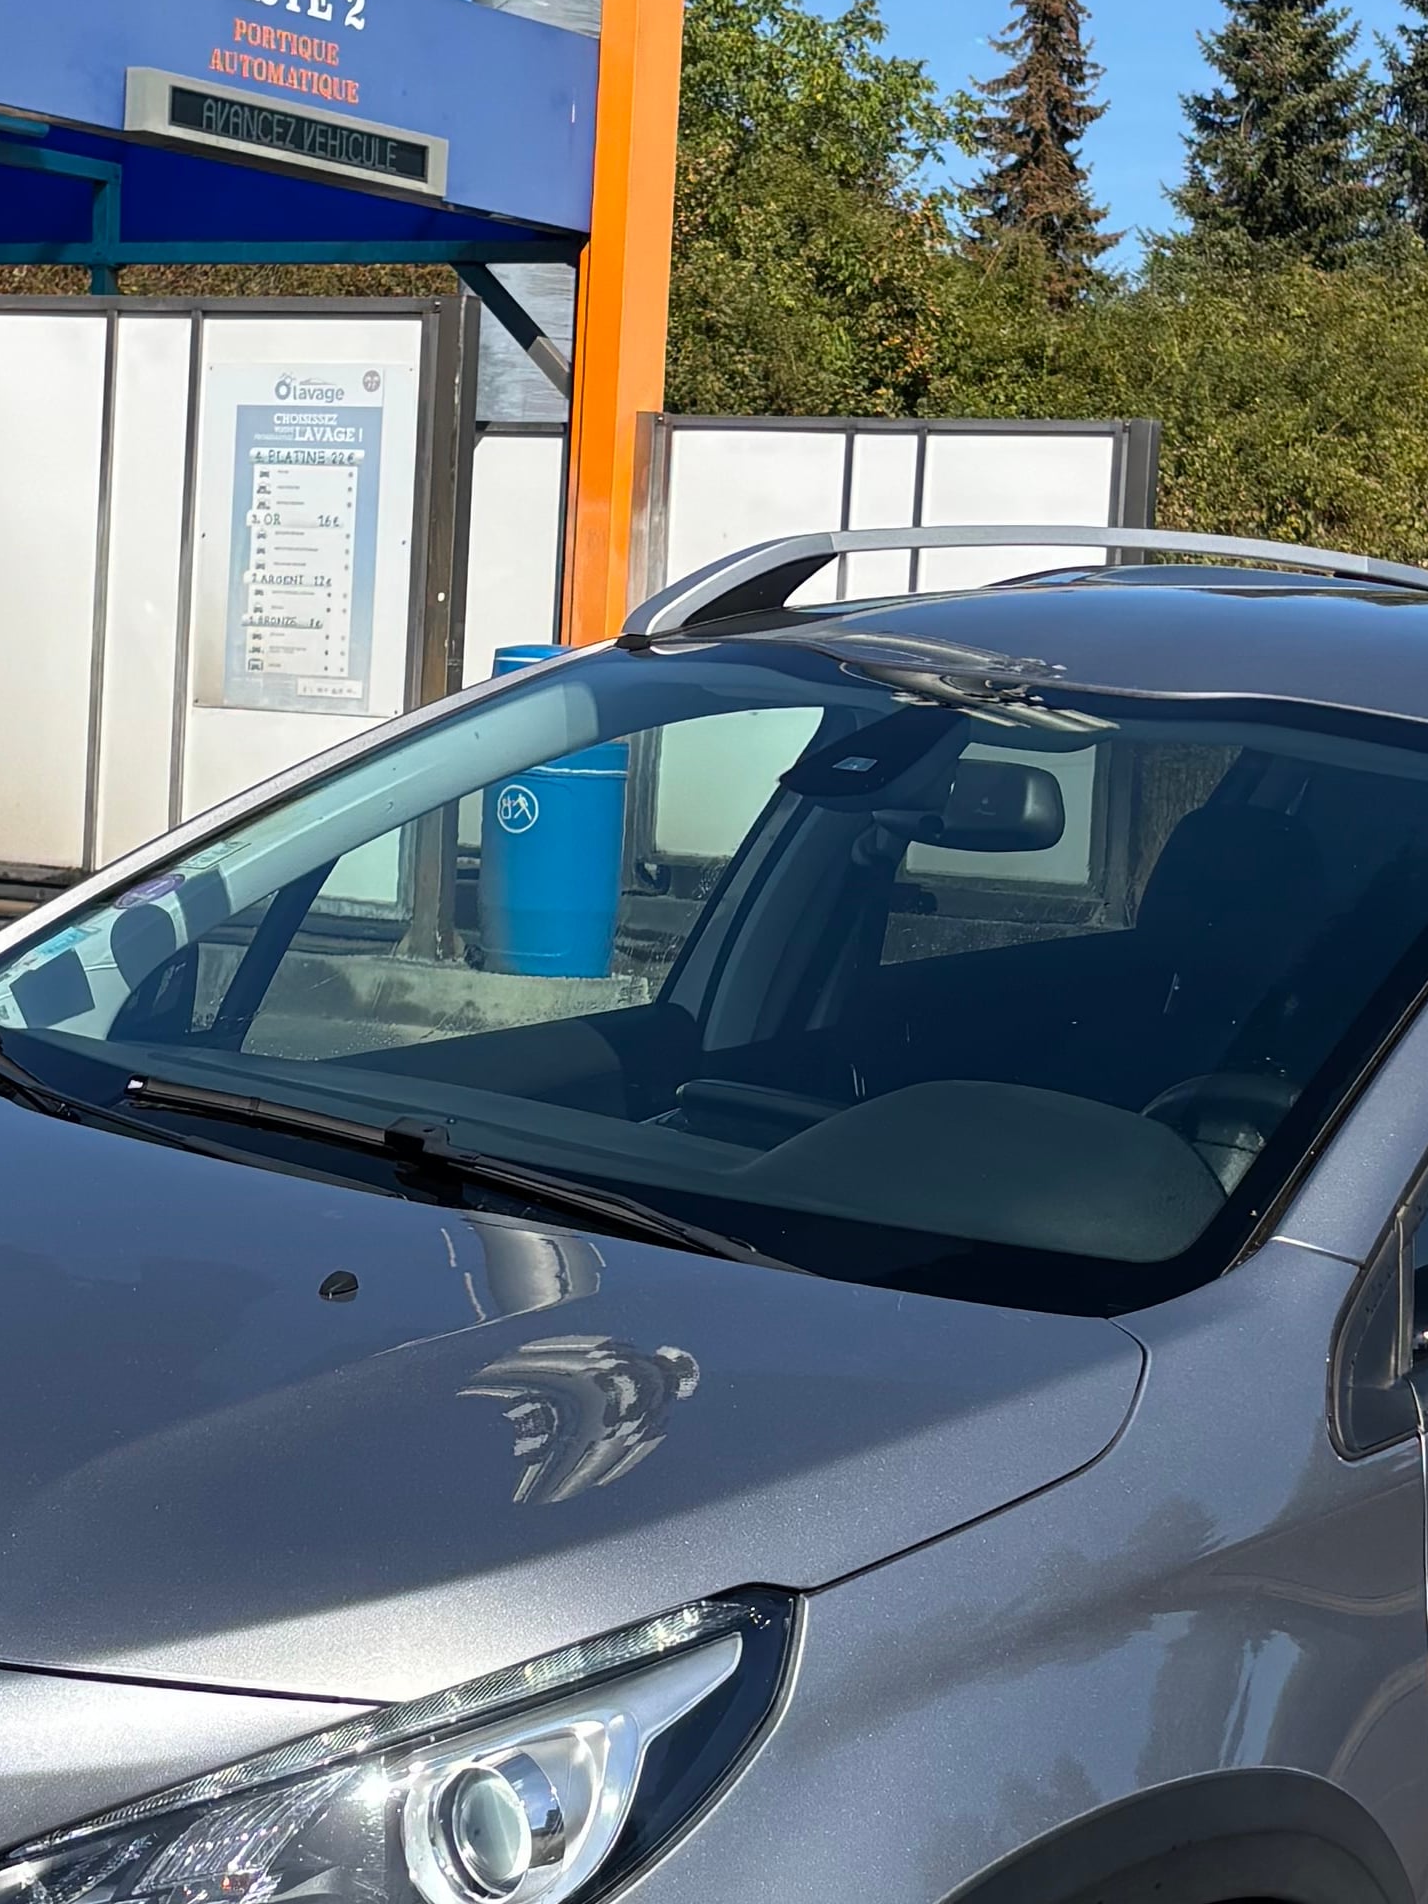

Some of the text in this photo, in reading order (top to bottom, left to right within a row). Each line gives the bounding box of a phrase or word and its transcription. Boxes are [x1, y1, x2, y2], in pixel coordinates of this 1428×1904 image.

[233, 17, 340, 67] PORTIQUE
[208, 47, 359, 104] AUTOMATIQUE
[202, 98, 398, 172] AVANCEZ VEHICULE
[274, 413, 339, 426] CHOISISSEZ
[294, 427, 356, 442] LAVAGE
[263, 512, 281, 526] OR
